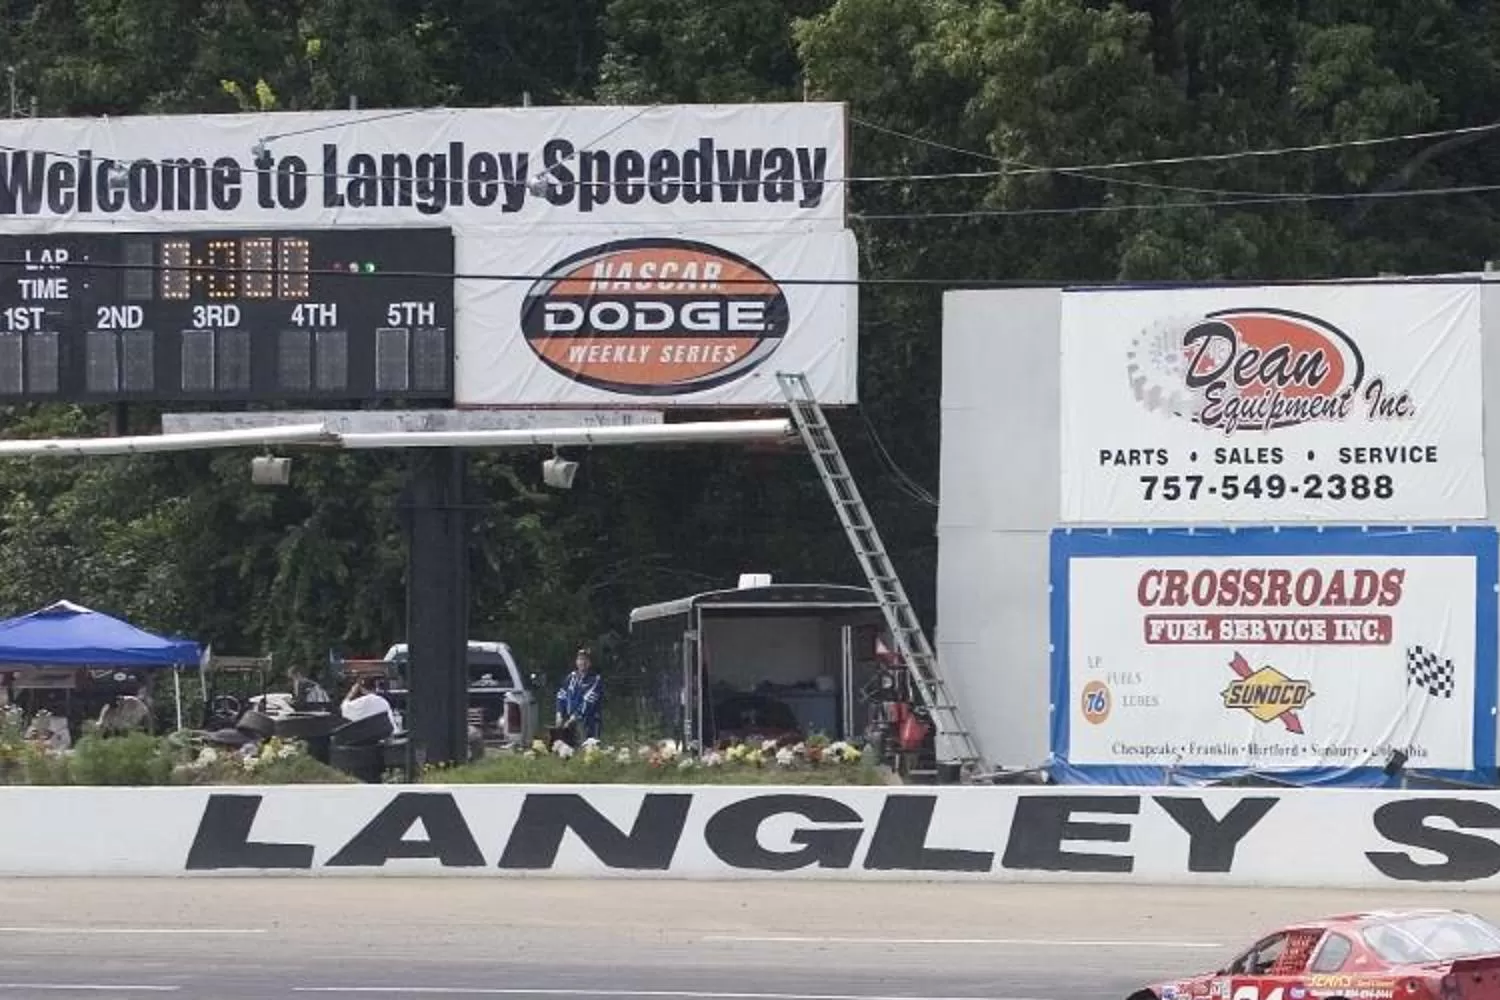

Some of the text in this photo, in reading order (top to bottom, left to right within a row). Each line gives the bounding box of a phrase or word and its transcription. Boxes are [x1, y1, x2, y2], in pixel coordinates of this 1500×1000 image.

[0, 149, 242, 215] Welcome
[254, 148, 307, 209] to
[25, 249, 69, 271] LAP
[18, 279, 69, 300] TIME
[588, 261, 724, 292] NASCAR
[3, 302, 436, 331] 1ST 2ND 3RD 4TH 5TH
[544, 301, 767, 332] DODGE
[567, 343, 738, 364] WEEKLY SERIES
[1183, 321, 1329, 388] Dean
[1200, 379, 1416, 435] Equipment Inc.
[1100, 446, 1438, 466] PARTS SALES SERVICE
[1140, 473, 1394, 500] 757-549-2388
[1138, 568, 1405, 607] CROSSROADS
[1148, 618, 1386, 642] FUEL SERVICE INC.
[1086, 691, 1105, 712] 76
[1230, 684, 1307, 706] SUNOCO
[1112, 742, 1177, 761] Chesapeake
[1189, 742, 1239, 757] Franklin
[185, 791, 1279, 873] LANGLEY
